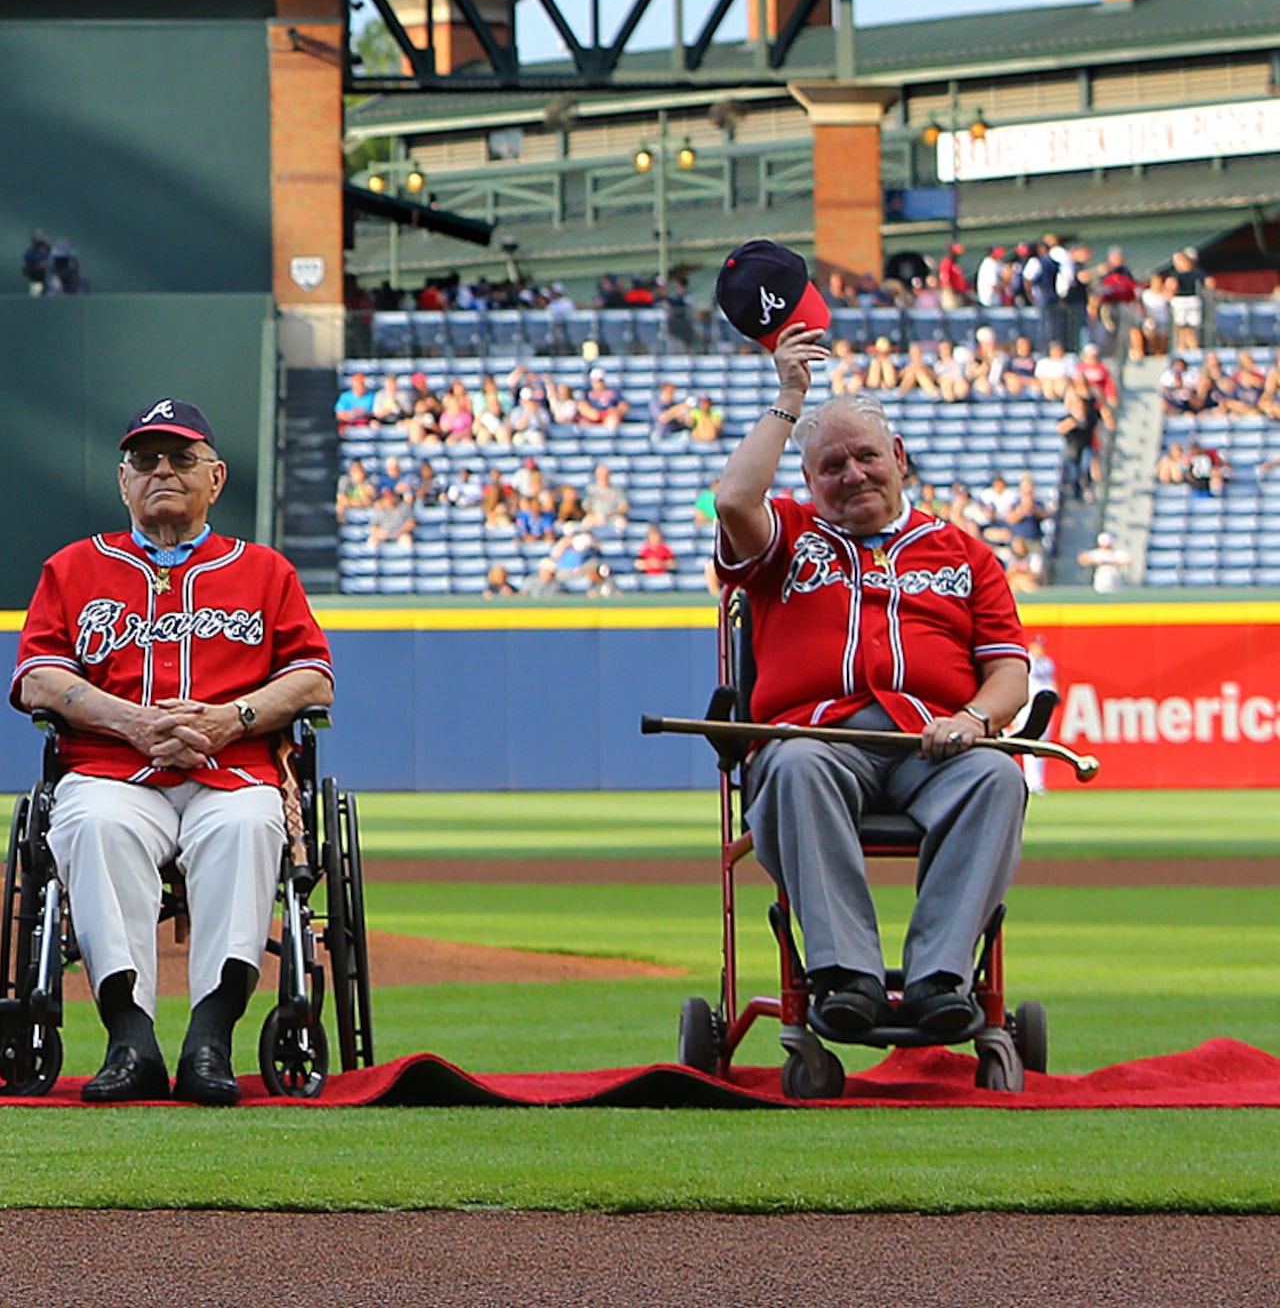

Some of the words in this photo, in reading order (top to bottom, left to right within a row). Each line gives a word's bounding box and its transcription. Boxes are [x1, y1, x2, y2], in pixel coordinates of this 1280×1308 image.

[758, 285, 786, 327] A
[141, 398, 175, 422] A
[780, 530, 973, 604] Braves
[74, 598, 264, 665] Braves
[1058, 681, 1280, 744] Americ
